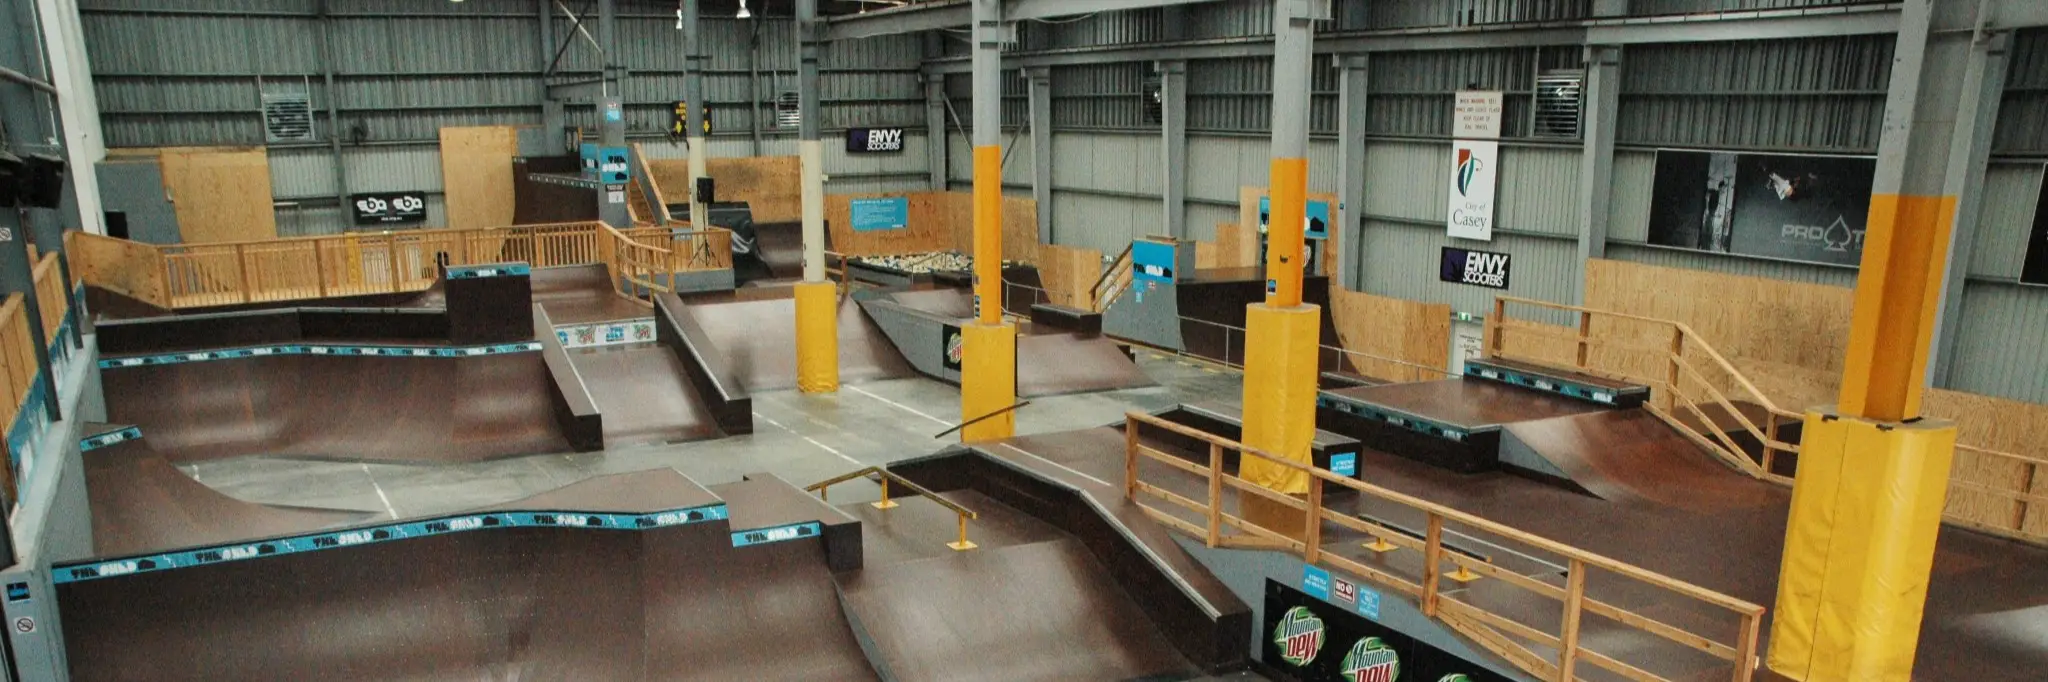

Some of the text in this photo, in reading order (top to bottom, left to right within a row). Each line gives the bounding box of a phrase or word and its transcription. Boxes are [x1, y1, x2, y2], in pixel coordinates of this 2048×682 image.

[869, 129, 902, 143] ENVY
[1479, 202, 1487, 210] of
[1453, 208, 1487, 231] Casey
[1781, 224, 1824, 241] PRO
[1465, 251, 1508, 275] ENVY
[1463, 271, 1504, 287] SCOOTERS
[1335, 580, 1346, 593] NO
[1283, 609, 1323, 638] Mountain
[1352, 640, 1396, 669] Mountain
